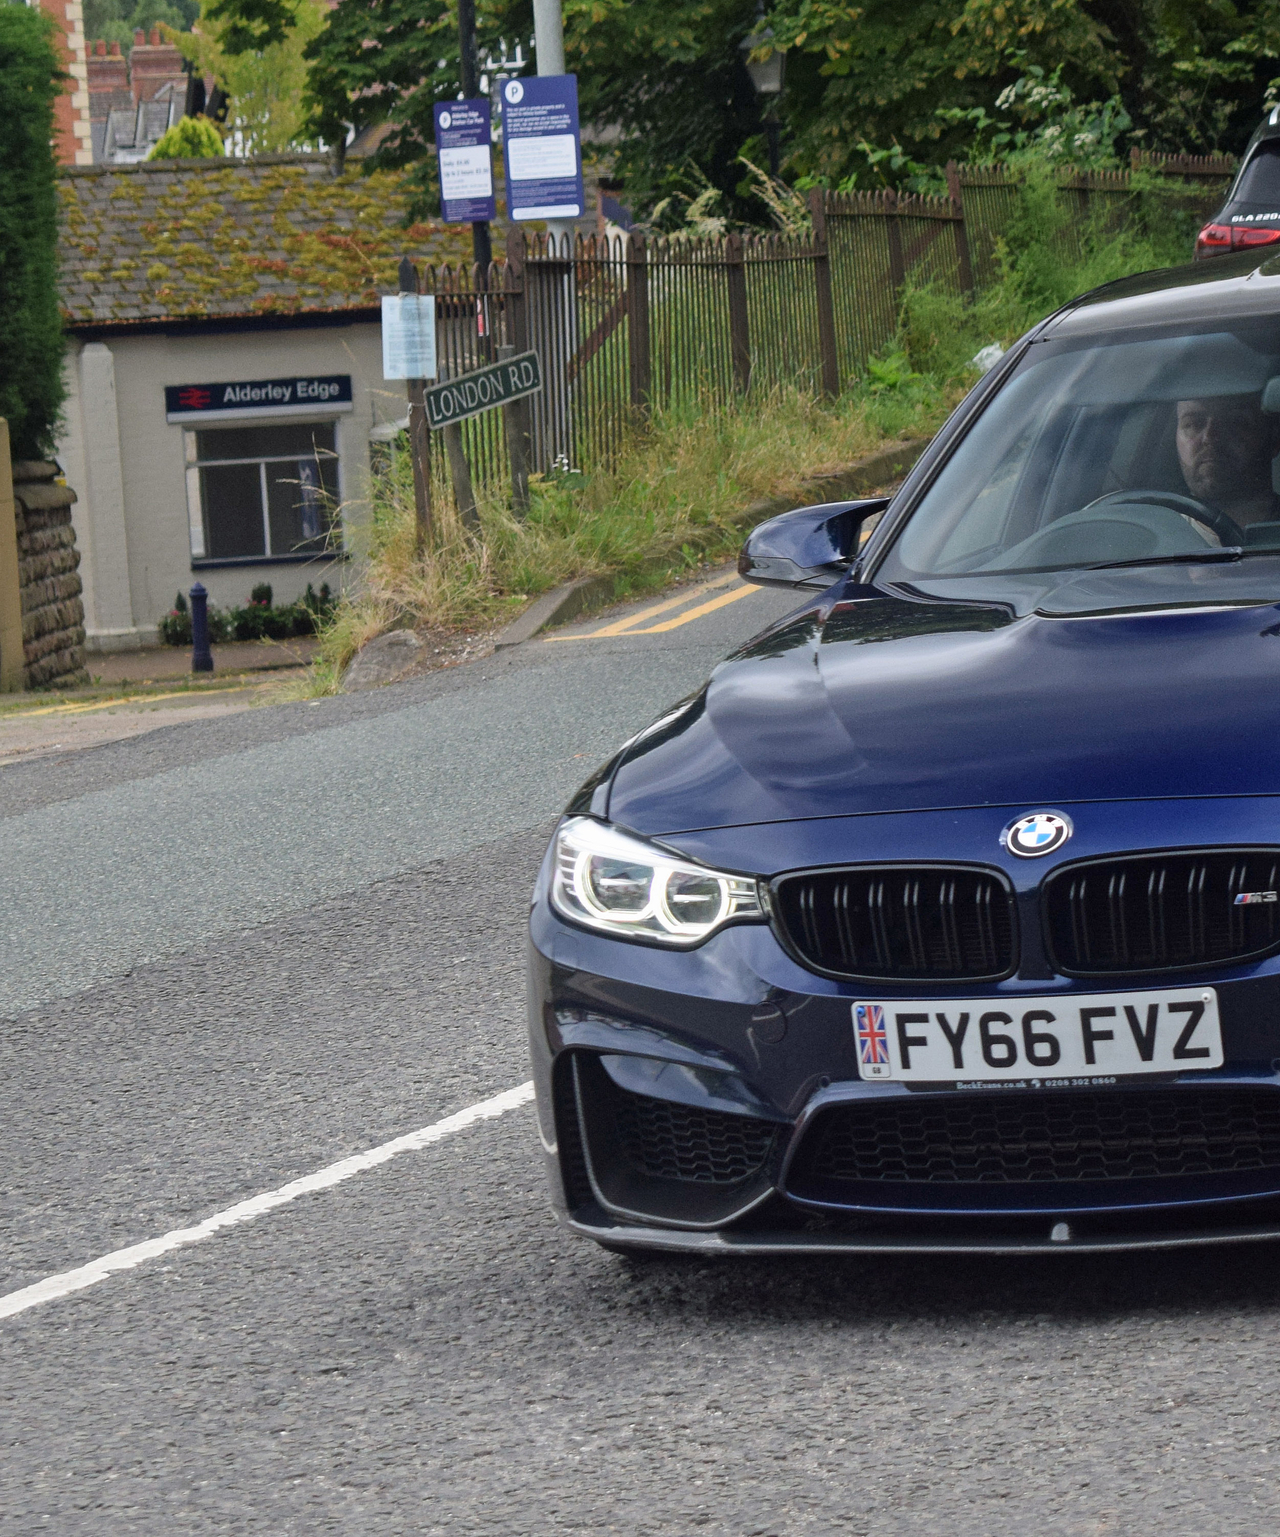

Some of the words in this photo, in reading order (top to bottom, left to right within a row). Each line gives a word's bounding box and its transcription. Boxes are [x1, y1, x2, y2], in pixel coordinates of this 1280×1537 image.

[223, 384, 292, 403] Alderley
[296, 380, 340, 400] Edge
[430, 371, 505, 421] LONDON
[508, 361, 538, 392] RD.
[895, 1010, 1062, 1070] FY66
[1079, 1000, 1211, 1065] FVZ
[1071, 1078, 1089, 1086] 302
